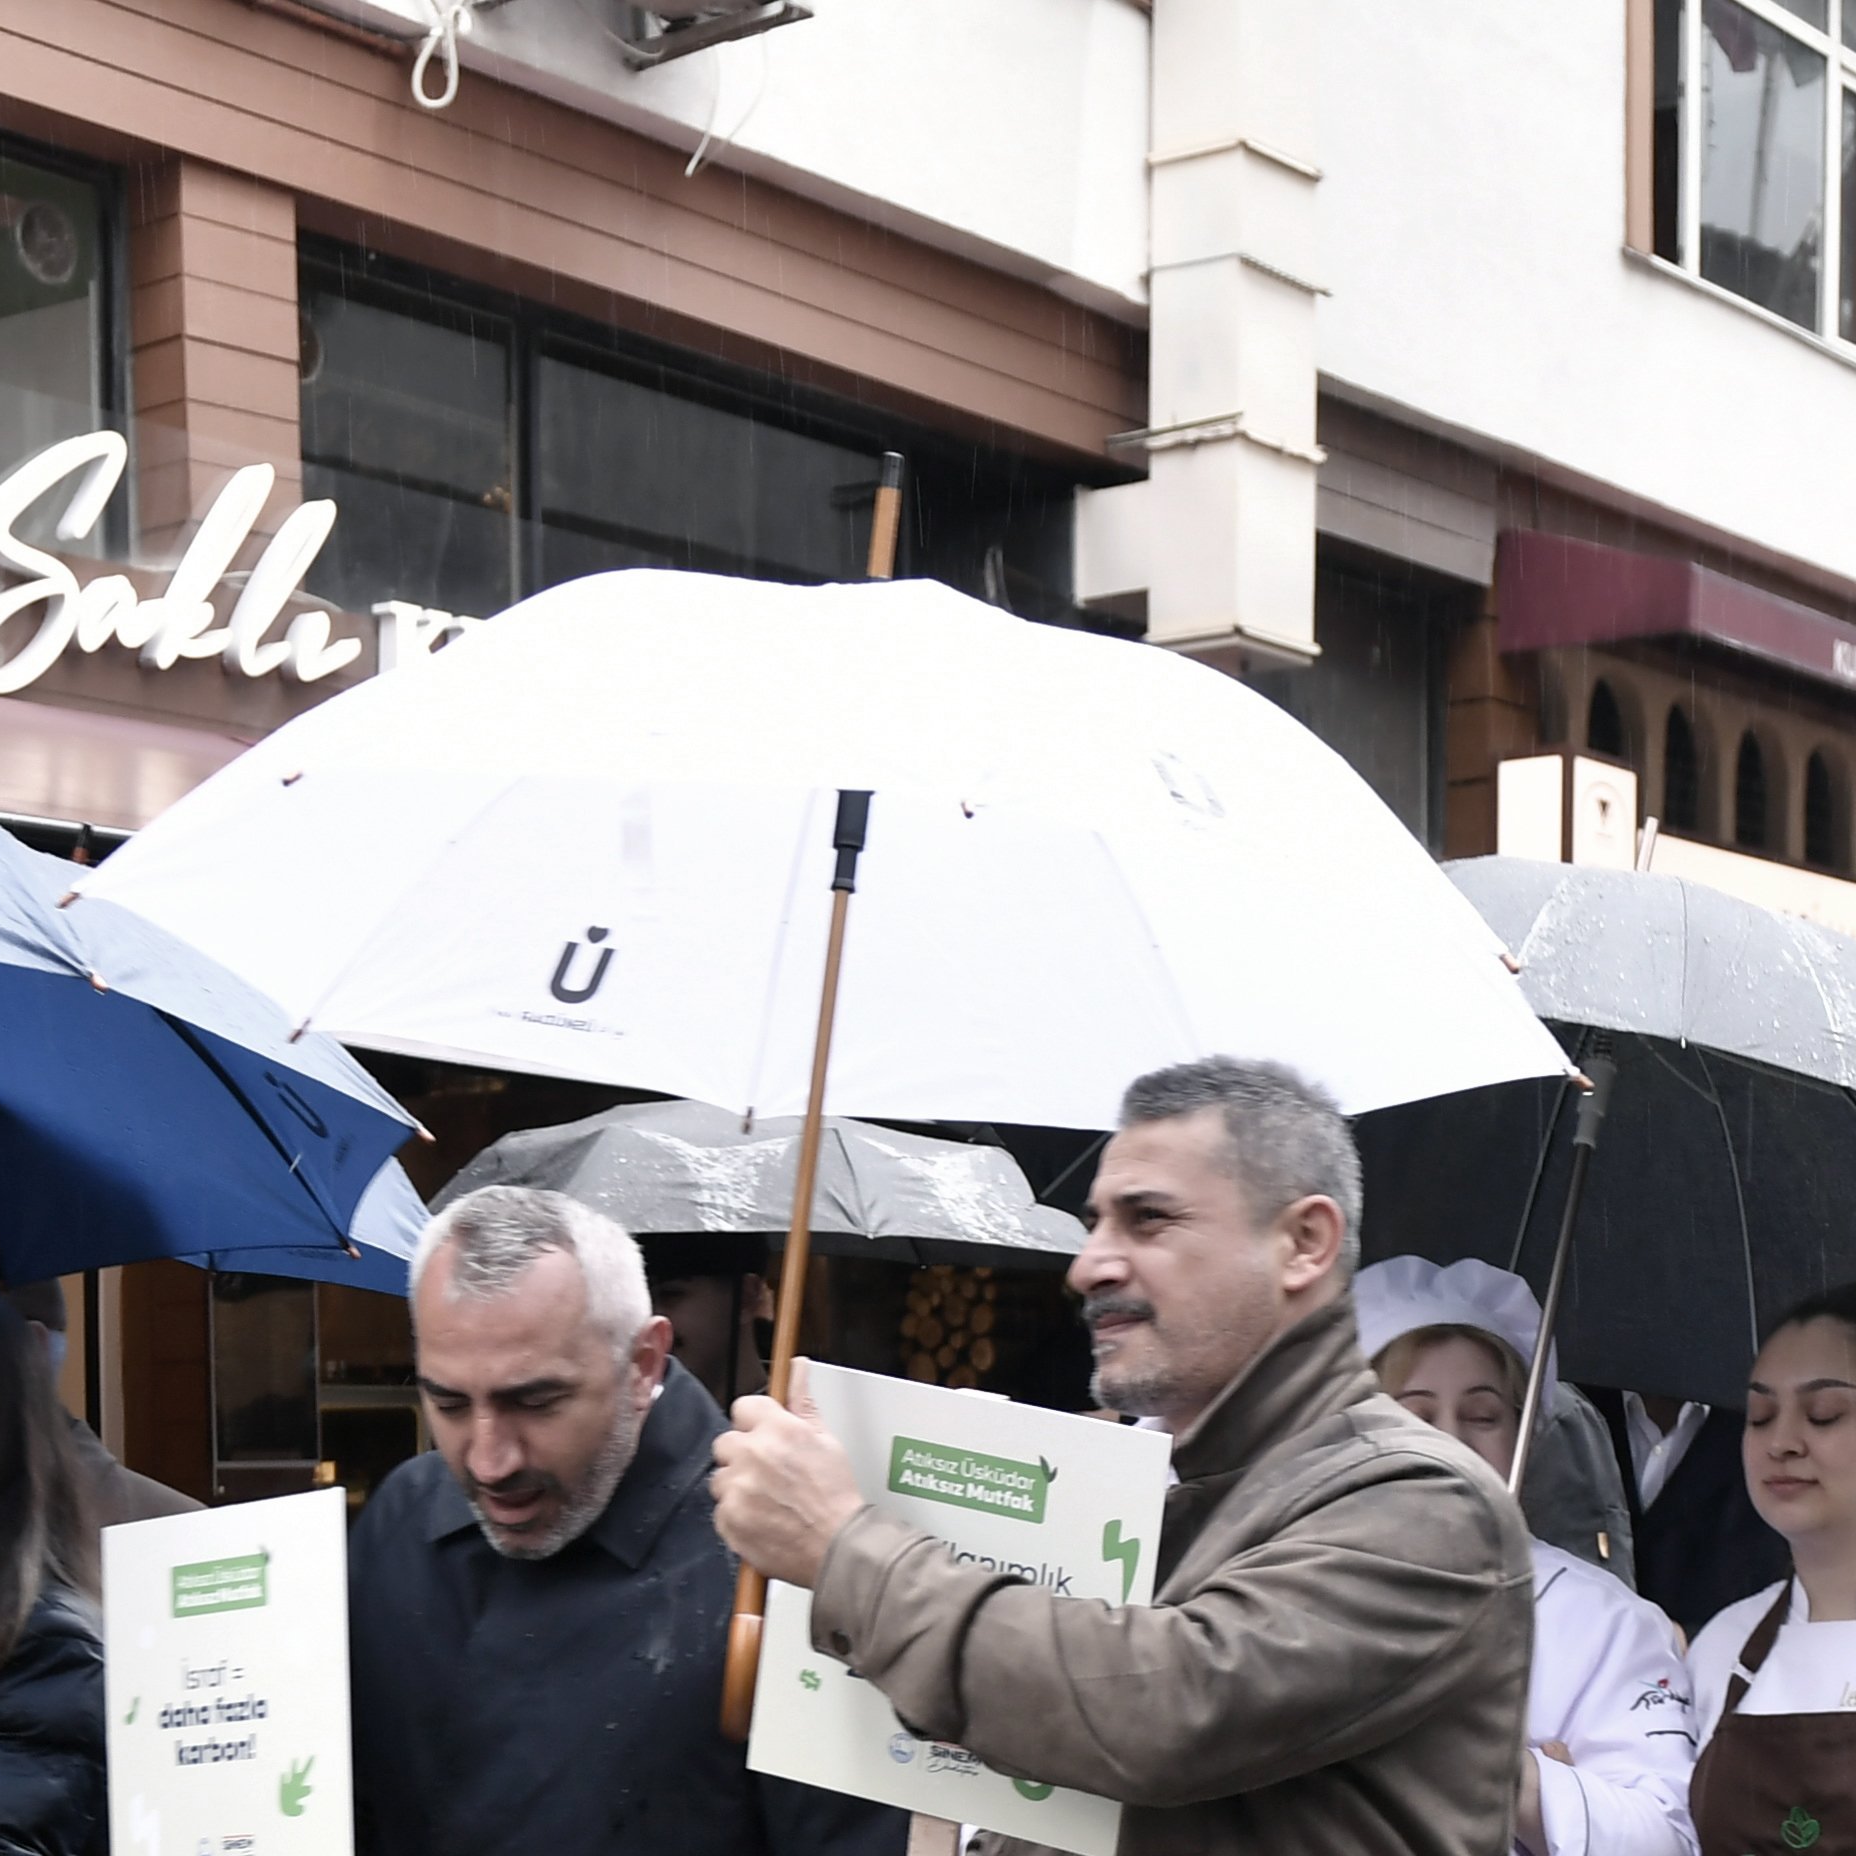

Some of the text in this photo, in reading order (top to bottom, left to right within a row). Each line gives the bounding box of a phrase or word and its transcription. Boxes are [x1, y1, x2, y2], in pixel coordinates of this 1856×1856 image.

[901, 1449, 1036, 1490] Atıksız Üsküdar
[899, 1469, 1035, 1512] Atıksız Mutfak
[158, 1693, 268, 1729] daha fazla
[175, 1733, 257, 1766] karbon!
